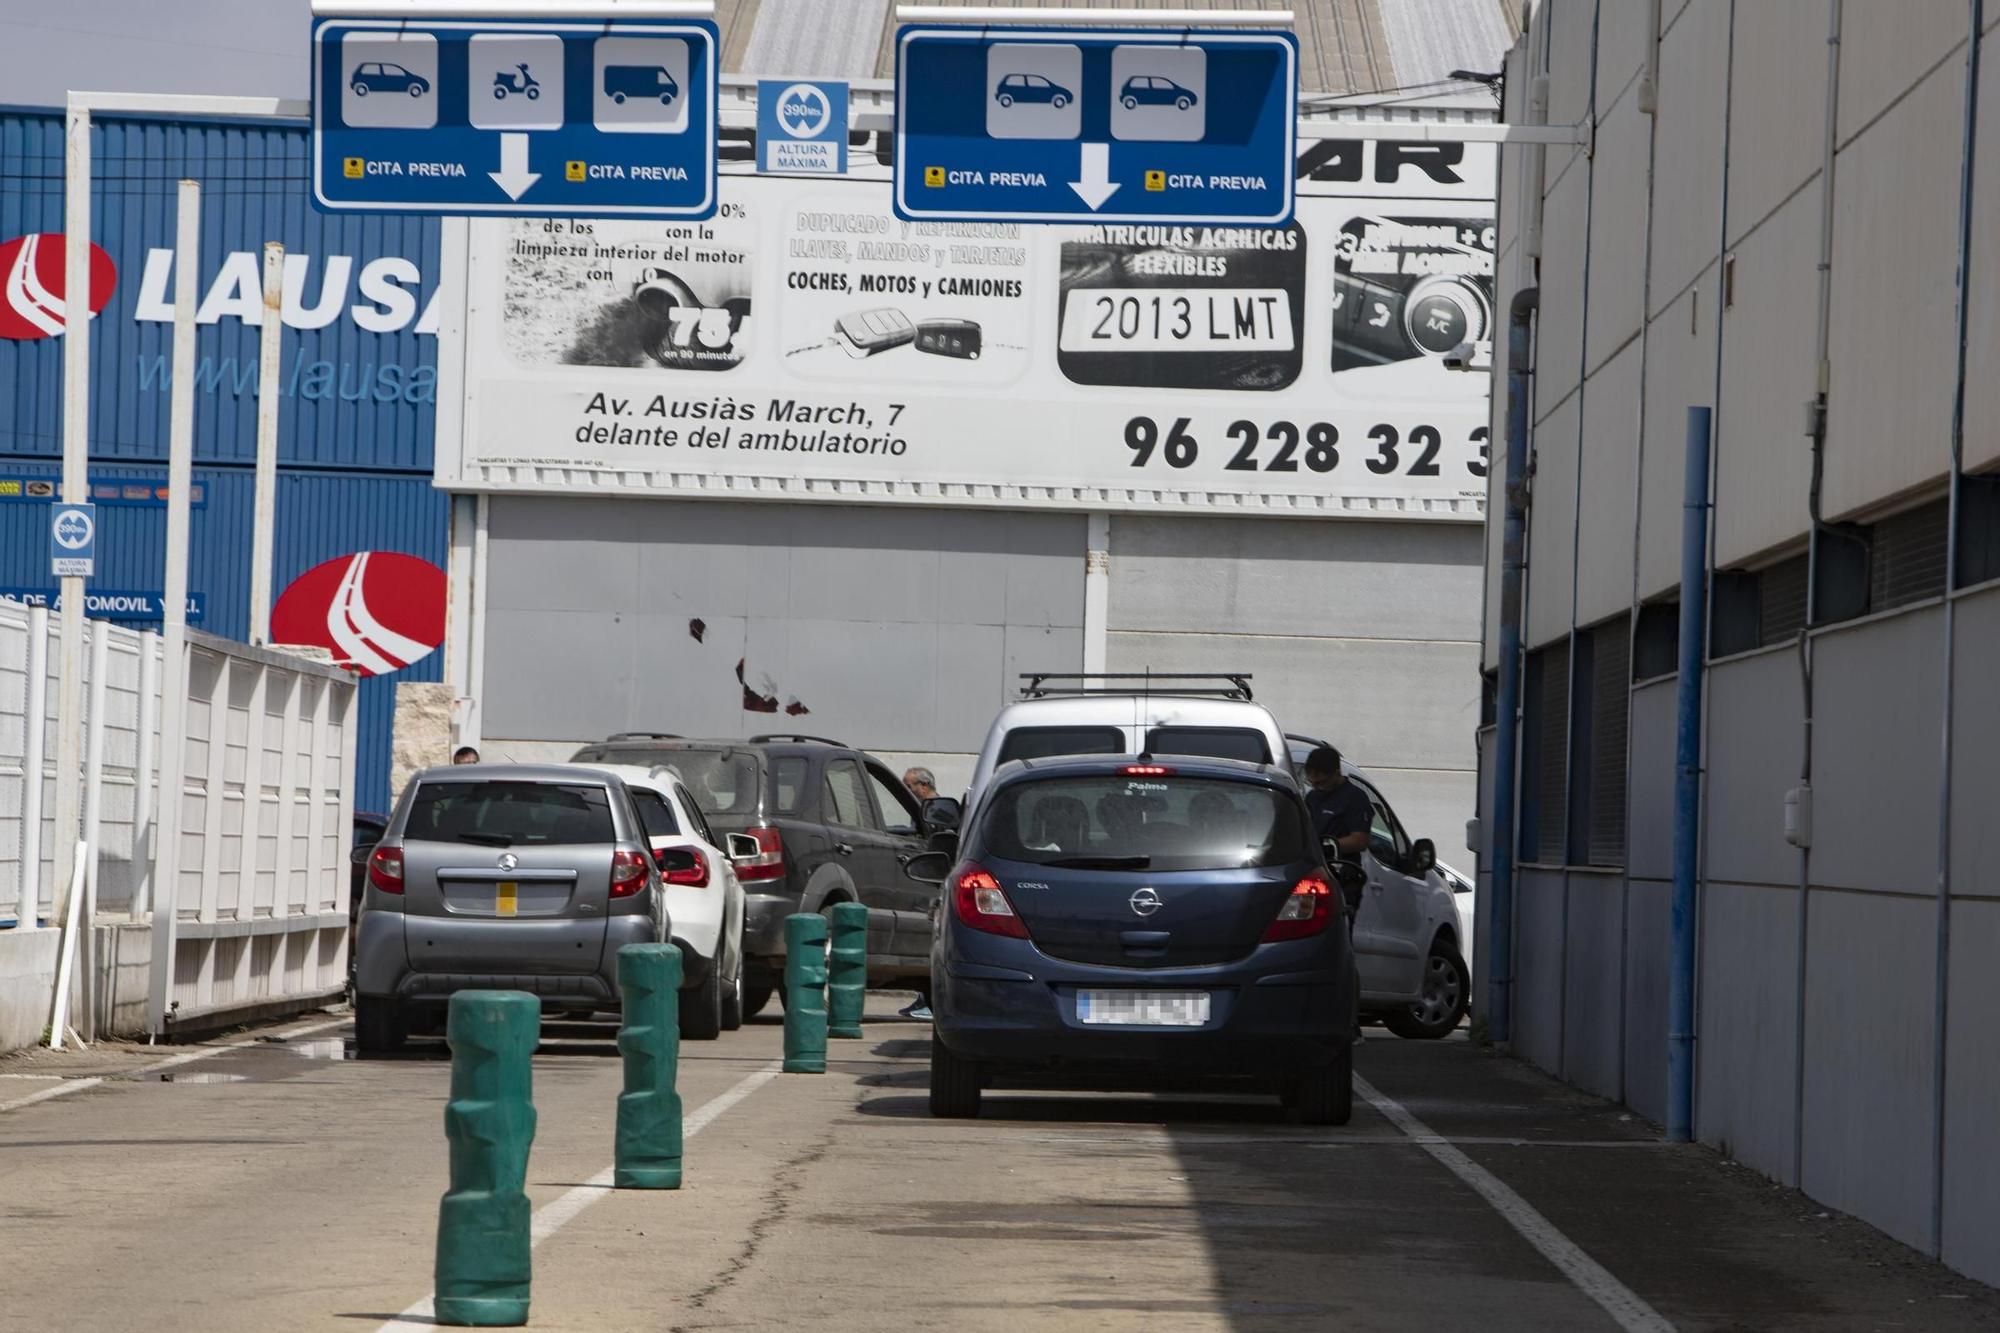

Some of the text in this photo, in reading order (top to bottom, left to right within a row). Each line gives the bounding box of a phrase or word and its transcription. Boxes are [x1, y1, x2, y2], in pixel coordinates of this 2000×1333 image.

[777, 144, 828, 155] ALTURA
[366, 161, 403, 175] CITA
[408, 162, 466, 177] PREVIA
[589, 165, 625, 179] CITA
[630, 166, 688, 180] PREVIA
[948, 171, 984, 185] CITA
[990, 172, 1047, 187] PREVIA
[1168, 174, 1204, 189] CITA
[1209, 175, 1267, 190] PREVIA
[543, 218, 593, 234] de los
[796, 211, 890, 234] DUPLICADO
[666, 224, 714, 240] con la
[515, 240, 745, 264] limpieza interior del motor
[789, 238, 1026, 268] LLAVES, MANDOS y TARJETAS
[1133, 253, 1227, 277] FLEXIBLES
[586, 269, 613, 281] con
[134, 247, 440, 334] LAUS
[787, 271, 1022, 299] COCHES, MOTOS y CAMIONES
[1091, 296, 1278, 340] 2013 LMT
[1426, 320, 1450, 335] A/C
[664, 350, 678, 358] en
[584, 391, 906, 429] Av. Ausiàs March, 7
[575, 421, 908, 456] delante del ambulatorio
[1123, 415, 1199, 469] 96
[1223, 419, 1339, 473] 228
[1365, 423, 1442, 476] 32
[1128, 782, 1168, 790] Palma
